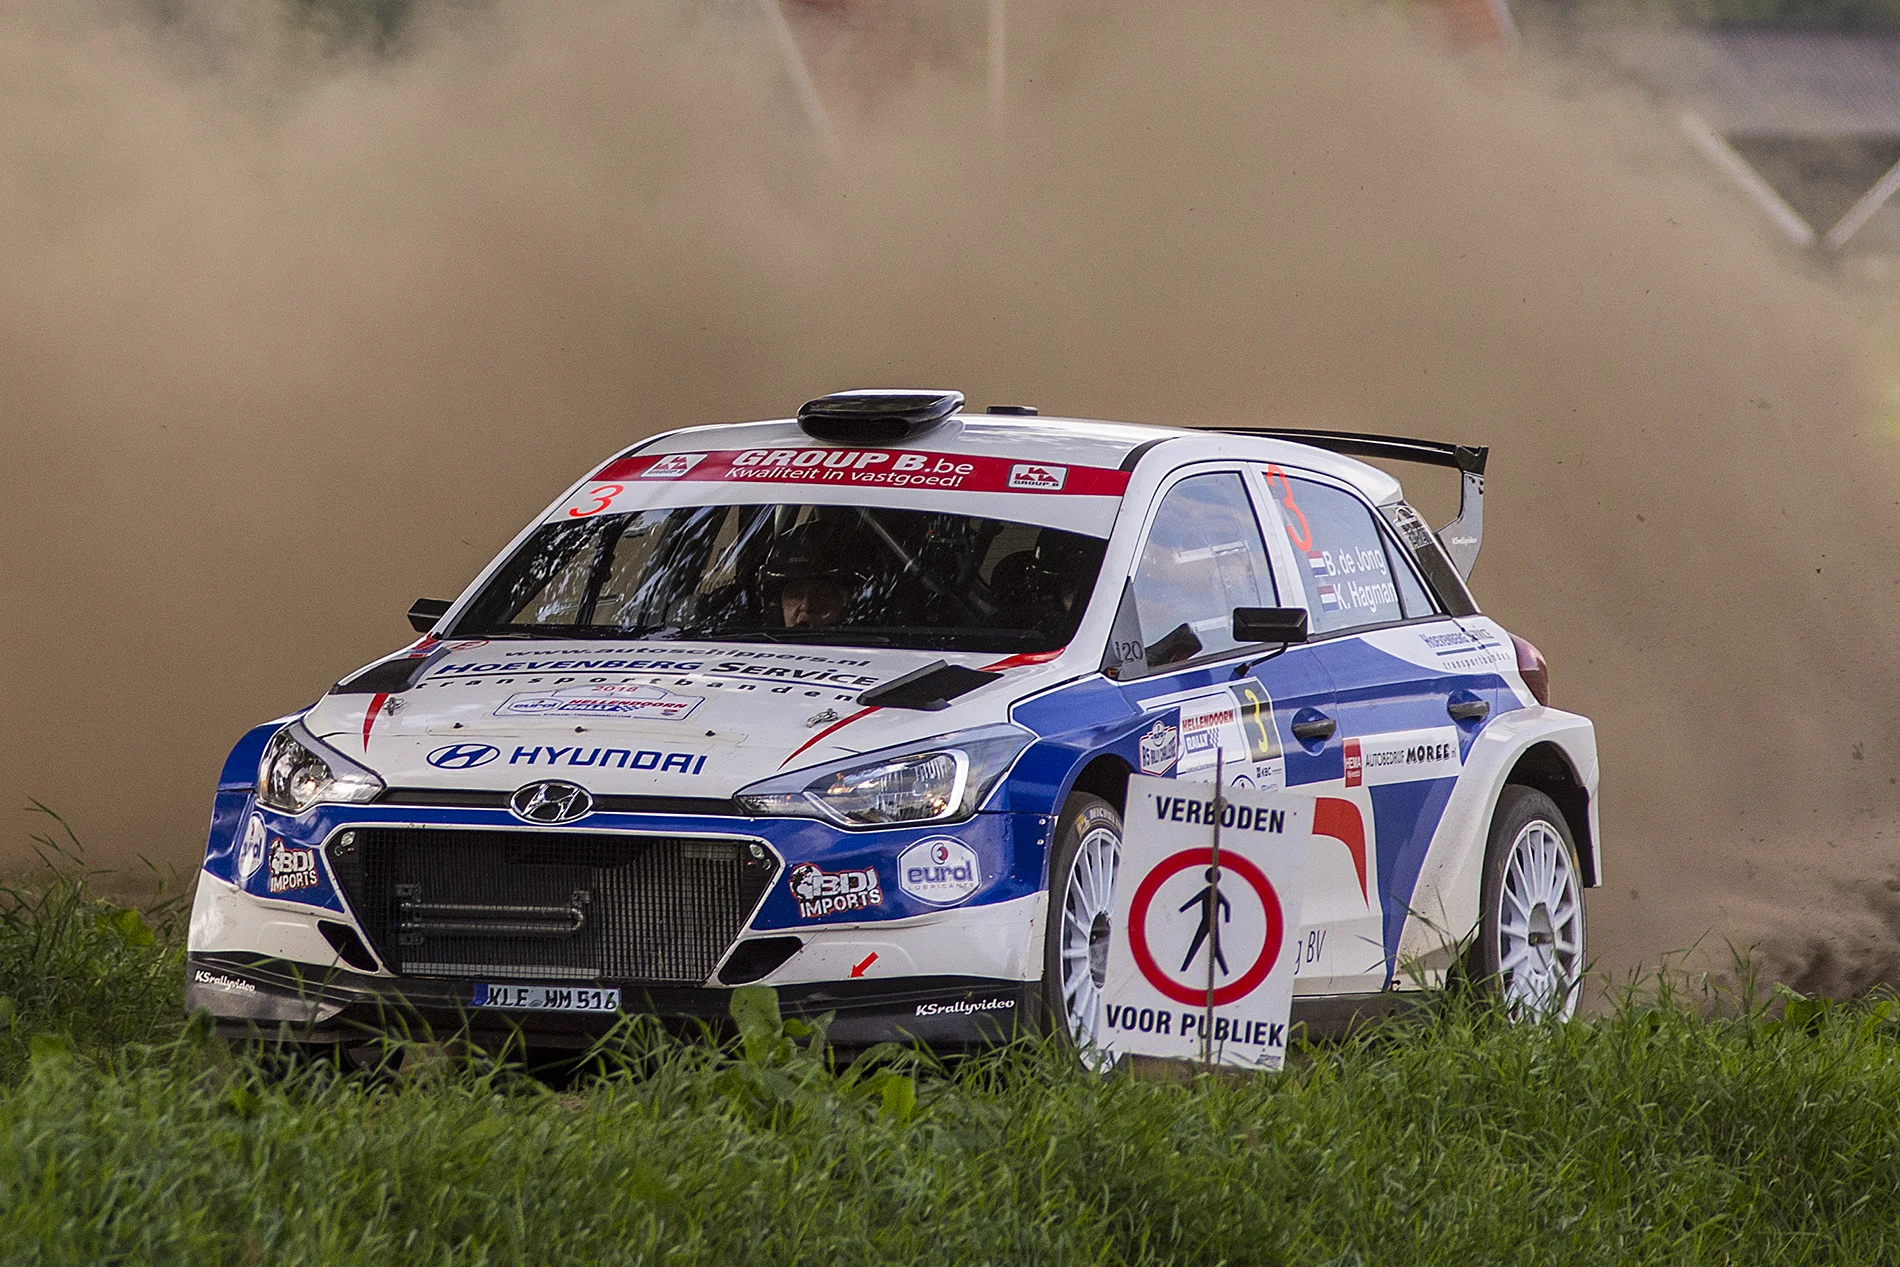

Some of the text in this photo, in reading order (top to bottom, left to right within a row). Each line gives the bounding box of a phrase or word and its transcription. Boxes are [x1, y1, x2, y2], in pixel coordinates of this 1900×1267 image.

[732, 449, 974, 475] GROUP B.be
[724, 466, 963, 488] Kwaliteit in vastgoed!
[1013, 479, 1049, 487] GROUP
[568, 484, 624, 517] 3
[1266, 463, 1312, 551] 3
[1324, 547, 1388, 578] B. de Jong
[1333, 581, 1399, 612] K. Hagman
[433, 660, 704, 674] HOEVENBERG
[505, 648, 872, 667] www.autoschippers.nl
[569, 699, 688, 708] HELLENDOORN
[1182, 709, 1234, 733] HELLENDOORN
[1244, 689, 1268, 753] 3
[1186, 732, 1209, 751] RALLY
[509, 746, 707, 775] HYUNDAI
[1406, 743, 1450, 765] MOREE
[1156, 795, 1286, 834] VERBODEN
[270, 870, 317, 892] IMPORTS
[907, 860, 974, 883] eurol
[908, 883, 974, 891] LUBRICANTS
[800, 889, 881, 918] IMPORTS
[1306, 930, 1326, 963] BV
[194, 969, 256, 992] KSrallyvideo
[487, 987, 529, 1006] KLE
[576, 991, 617, 1010] 516
[915, 999, 1015, 1016] KSrallyvideo
[1106, 1004, 1284, 1047] VOOR PUBLIEK
